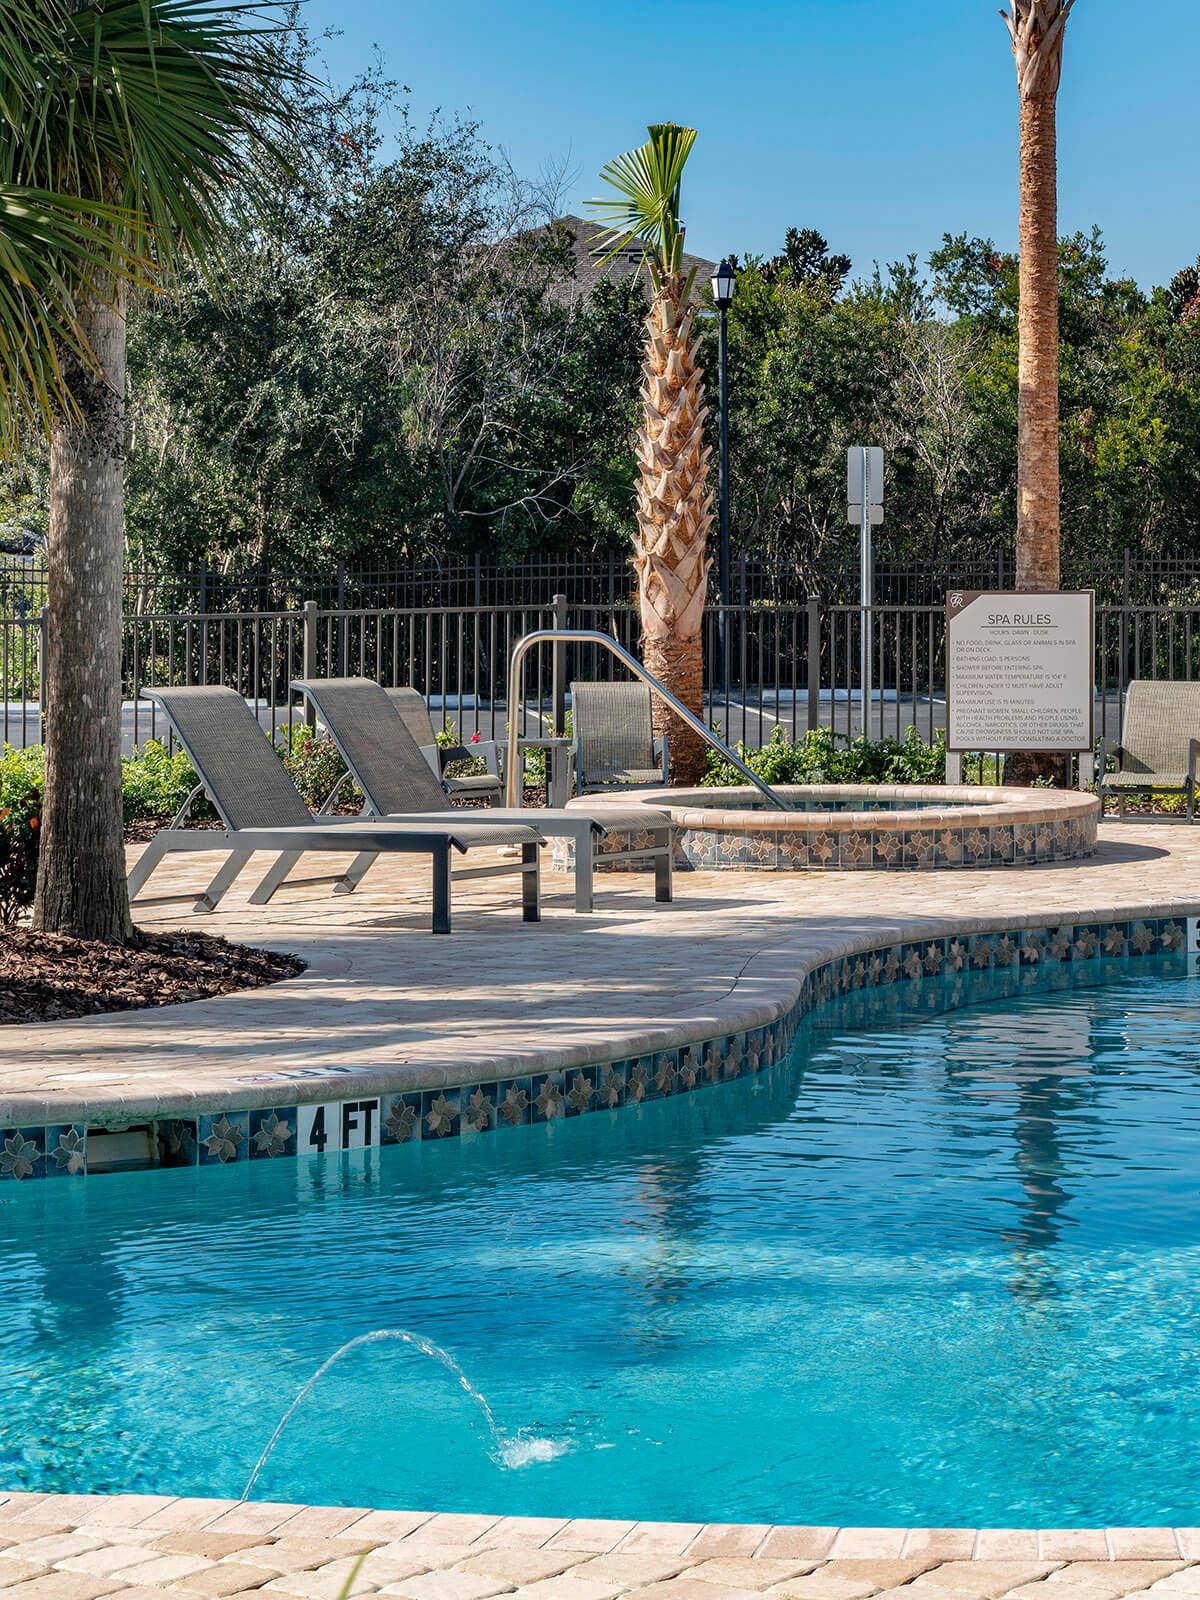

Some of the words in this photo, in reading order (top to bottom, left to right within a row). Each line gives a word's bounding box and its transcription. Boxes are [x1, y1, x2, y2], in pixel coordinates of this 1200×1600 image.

[988, 615, 1010, 624] SPA
[1014, 615, 1051, 624] RULES
[310, 1106, 327, 1152] 4
[343, 1100, 378, 1148] FT
